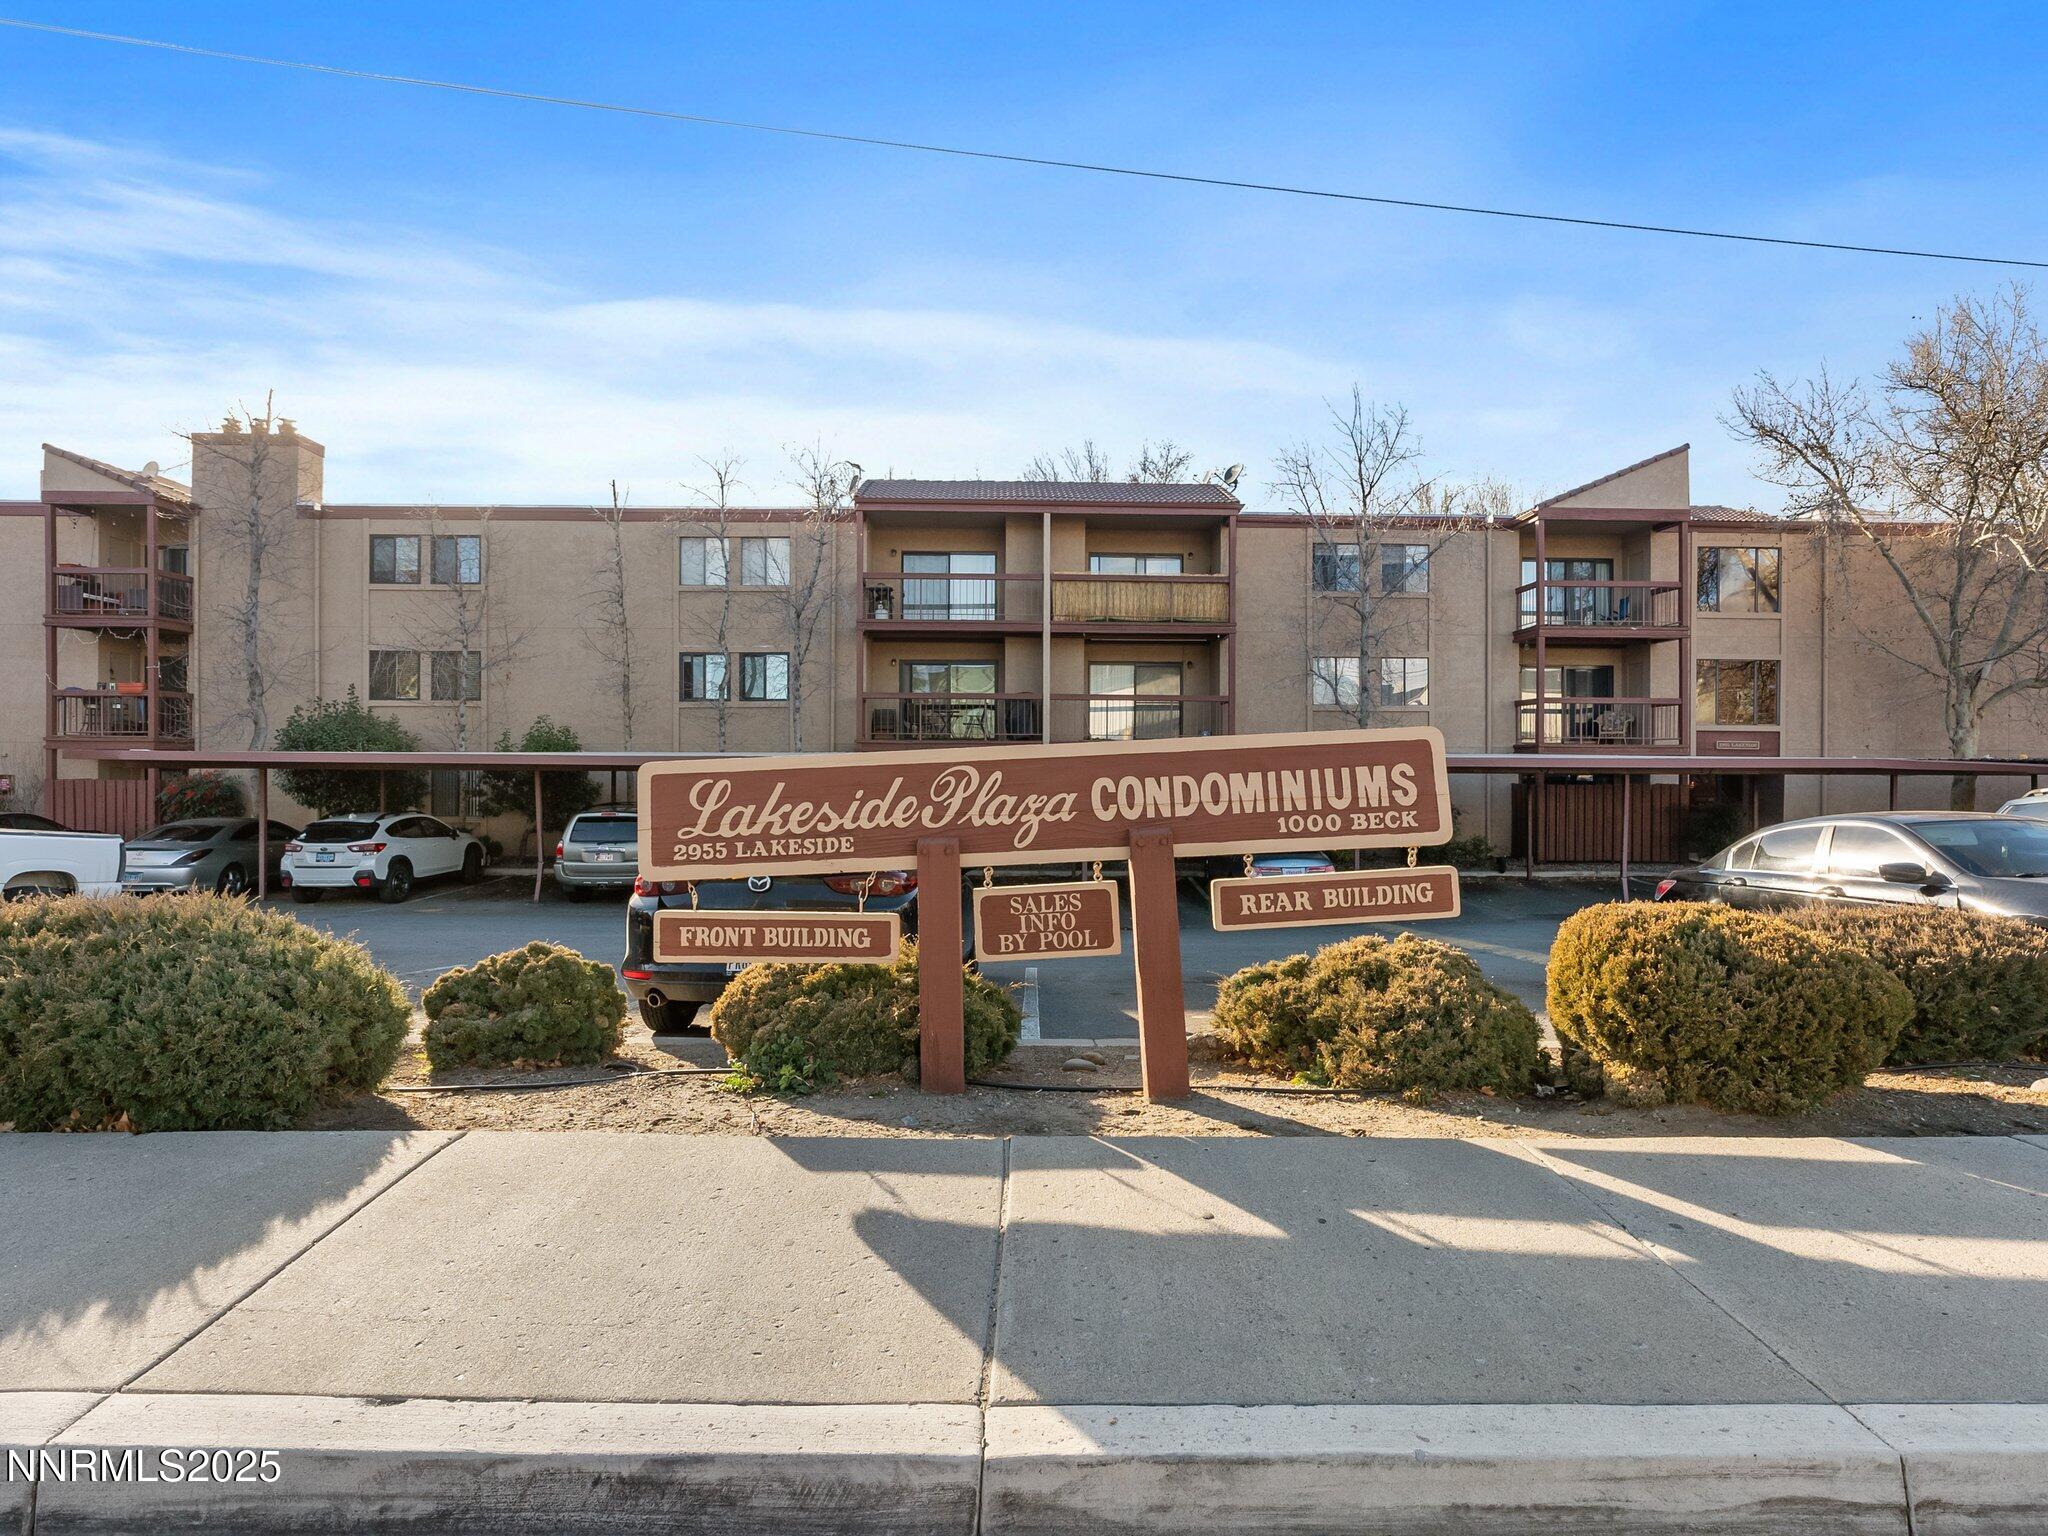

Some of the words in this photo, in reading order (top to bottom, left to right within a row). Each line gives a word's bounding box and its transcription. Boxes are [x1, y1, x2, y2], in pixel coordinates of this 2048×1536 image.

[677, 776, 920, 840] Lakeside
[921, 765, 1078, 849] Plaza
[1091, 762, 1418, 822] CONDOMINIUMS
[1277, 813, 1342, 833] 1000
[1349, 810, 1419, 830] BECK
[673, 841, 728, 861] 2955
[734, 836, 855, 858] LAKESIDE
[1010, 892, 1082, 915] SALES
[1239, 890, 1313, 916] REAR
[1322, 882, 1434, 909] BUILDING
[1019, 911, 1076, 934] INFO
[678, 926, 756, 947] FRONT
[762, 927, 872, 949] BUILDING
[998, 933, 1028, 953] BY
[1038, 929, 1098, 951] POOL
